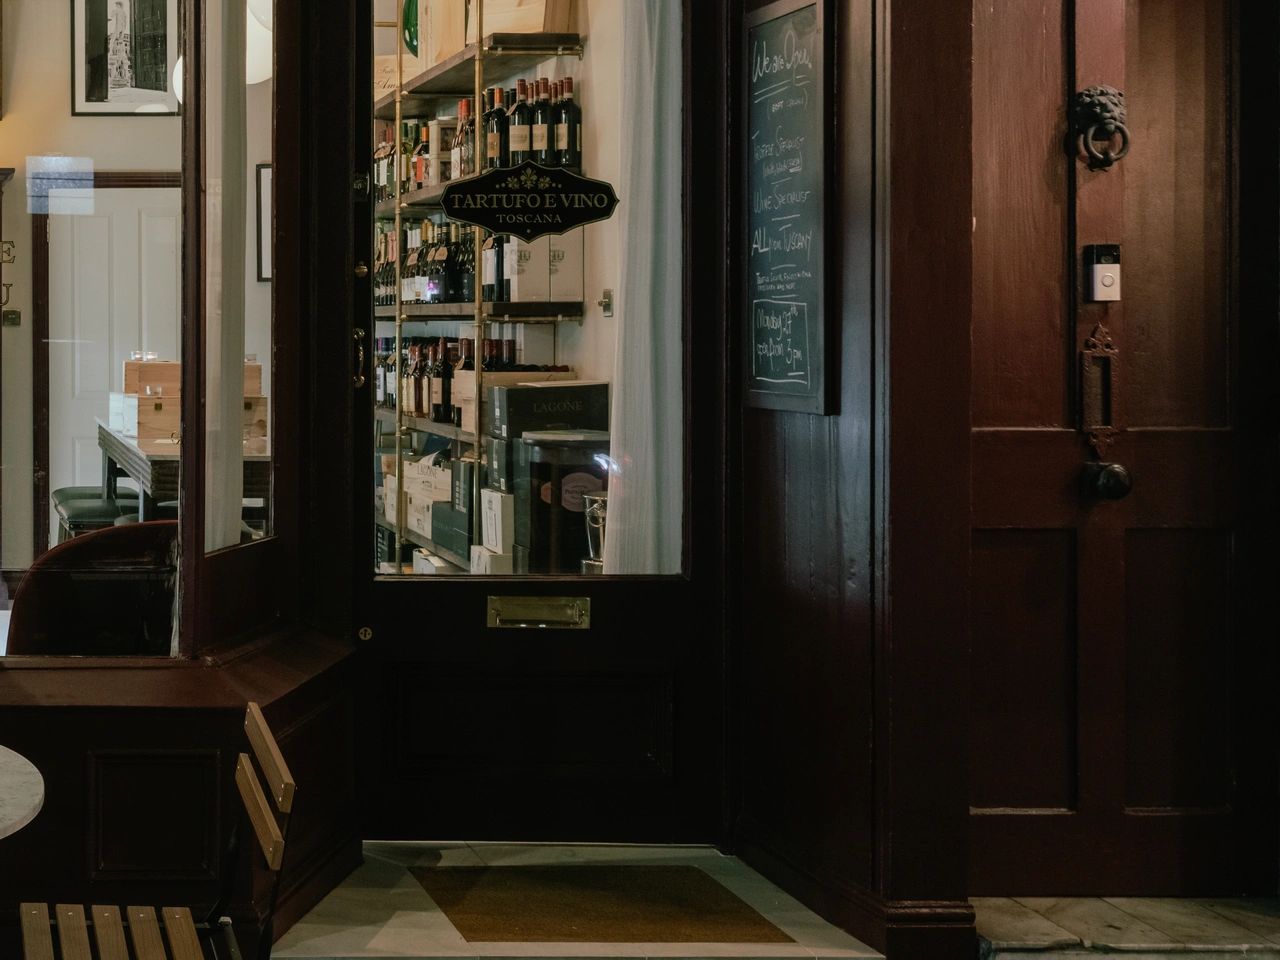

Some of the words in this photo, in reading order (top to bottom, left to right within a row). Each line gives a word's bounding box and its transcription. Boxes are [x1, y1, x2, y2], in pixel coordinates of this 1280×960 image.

[450, 193, 541, 208] TARTUFO
[544, 194, 557, 208] E
[560, 193, 608, 208] VINO
[496, 214, 562, 224] TOSCANA
